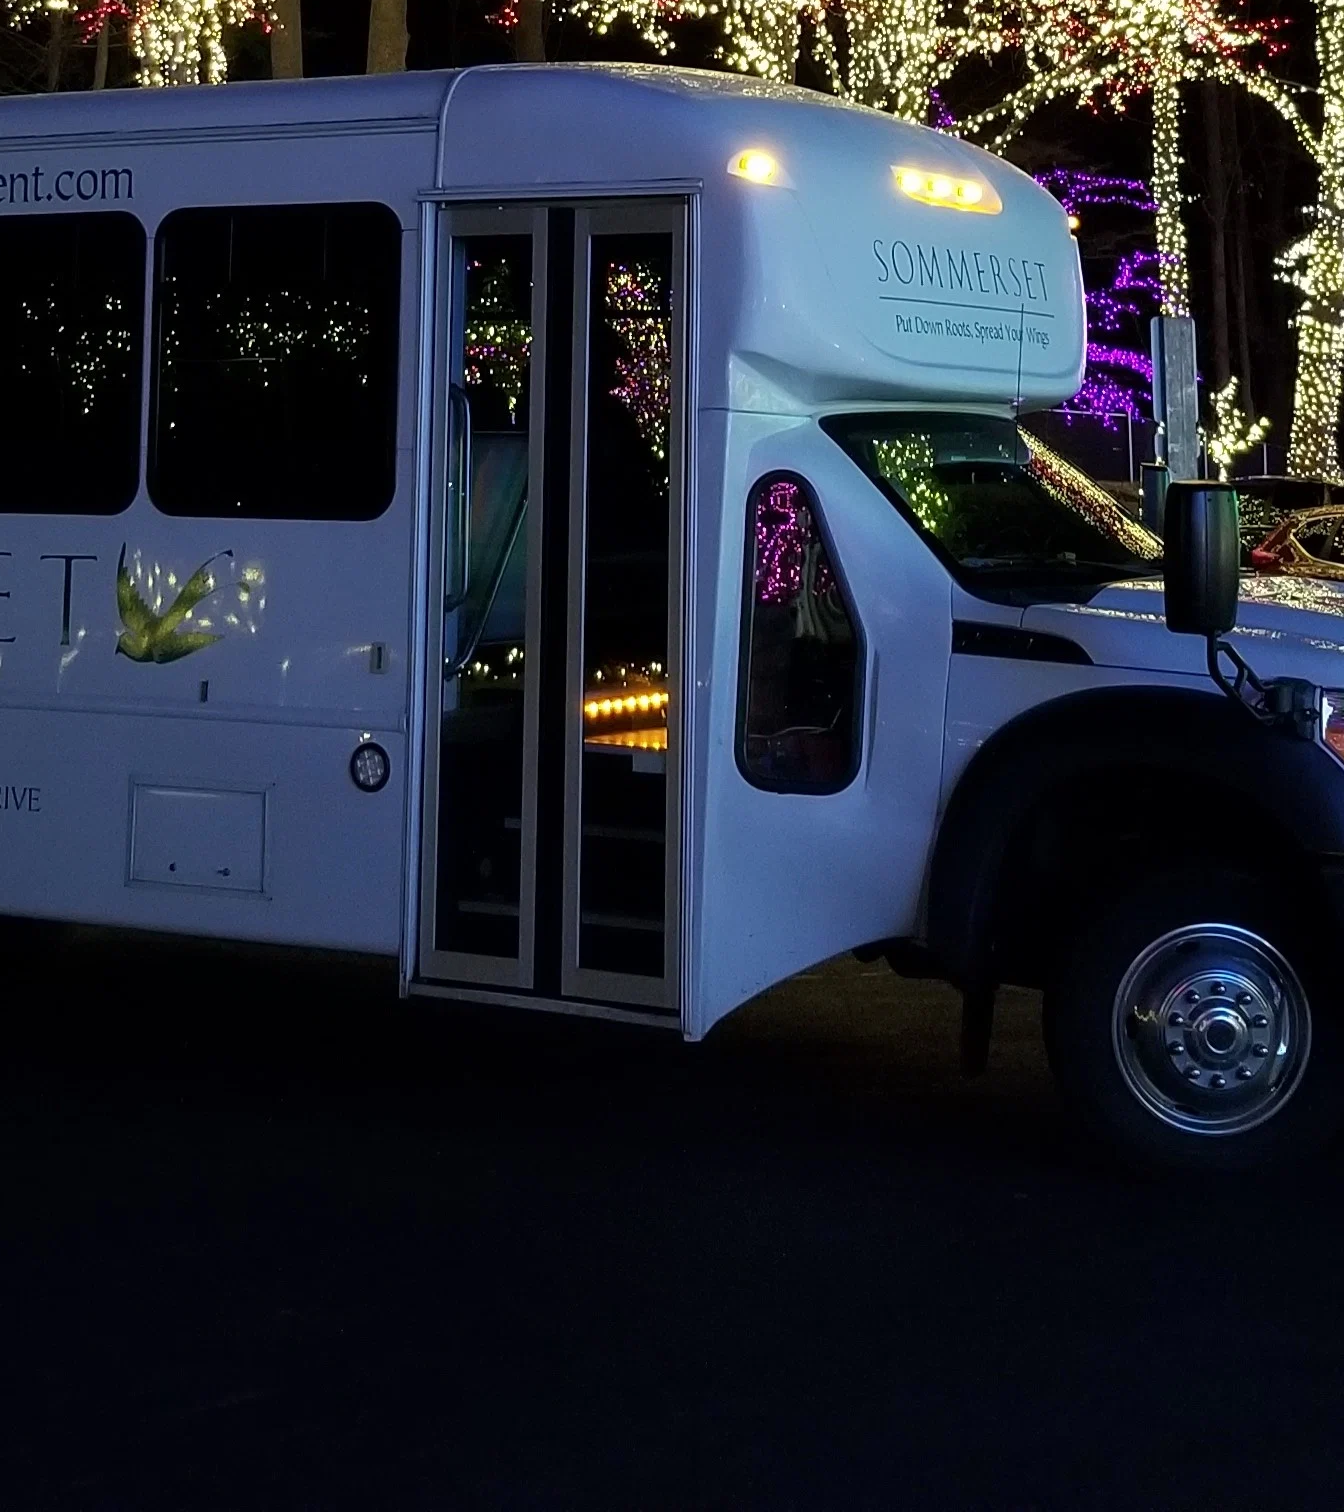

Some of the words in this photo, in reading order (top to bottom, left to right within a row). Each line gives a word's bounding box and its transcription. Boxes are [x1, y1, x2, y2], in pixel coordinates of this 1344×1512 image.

[872, 238, 1049, 303] SOMMERSET
[895, 314, 913, 334] Put
[914, 315, 944, 337] Down
[944, 318, 974, 339] Roots,
[974, 321, 1004, 345] Spread
[1004, 324, 1024, 343] You
[1025, 326, 1051, 351] Wings
